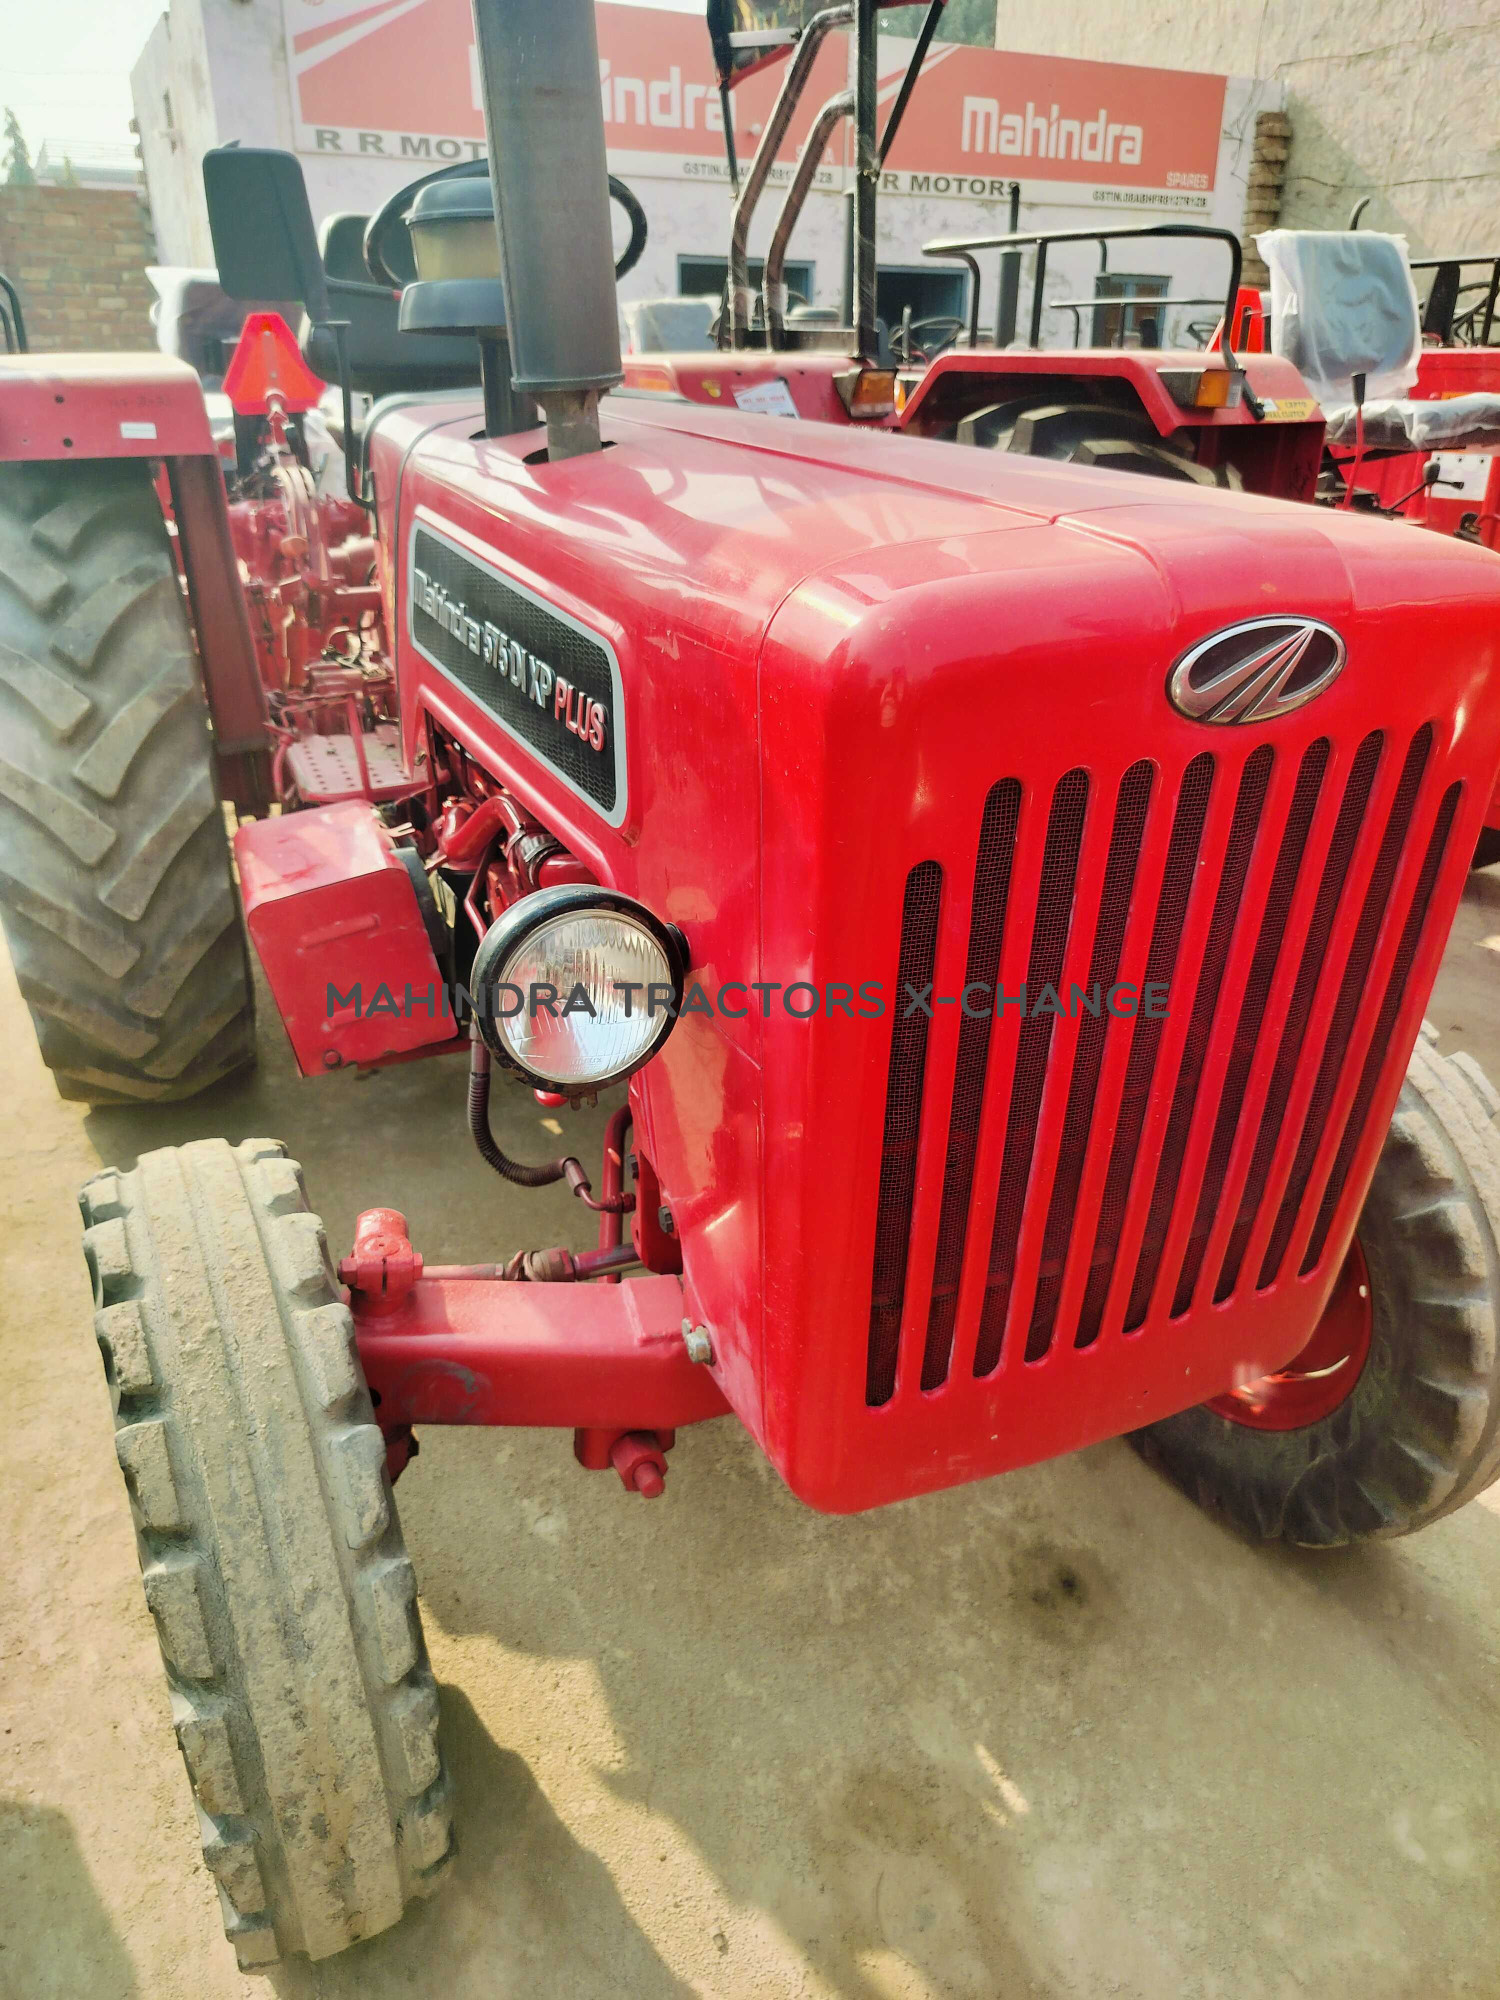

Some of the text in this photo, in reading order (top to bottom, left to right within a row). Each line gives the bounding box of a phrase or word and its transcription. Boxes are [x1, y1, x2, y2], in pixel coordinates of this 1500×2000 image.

[315, 129, 342, 151] R
[358, 132, 385, 154] R
[961, 95, 1143, 166] Mahindra
[883, 173, 899, 190] R
[1166, 171, 1209, 189] SPARES
[414, 567, 481, 656] Mahindra
[528, 654, 555, 709] XP
[554, 676, 608, 752] PLUS
